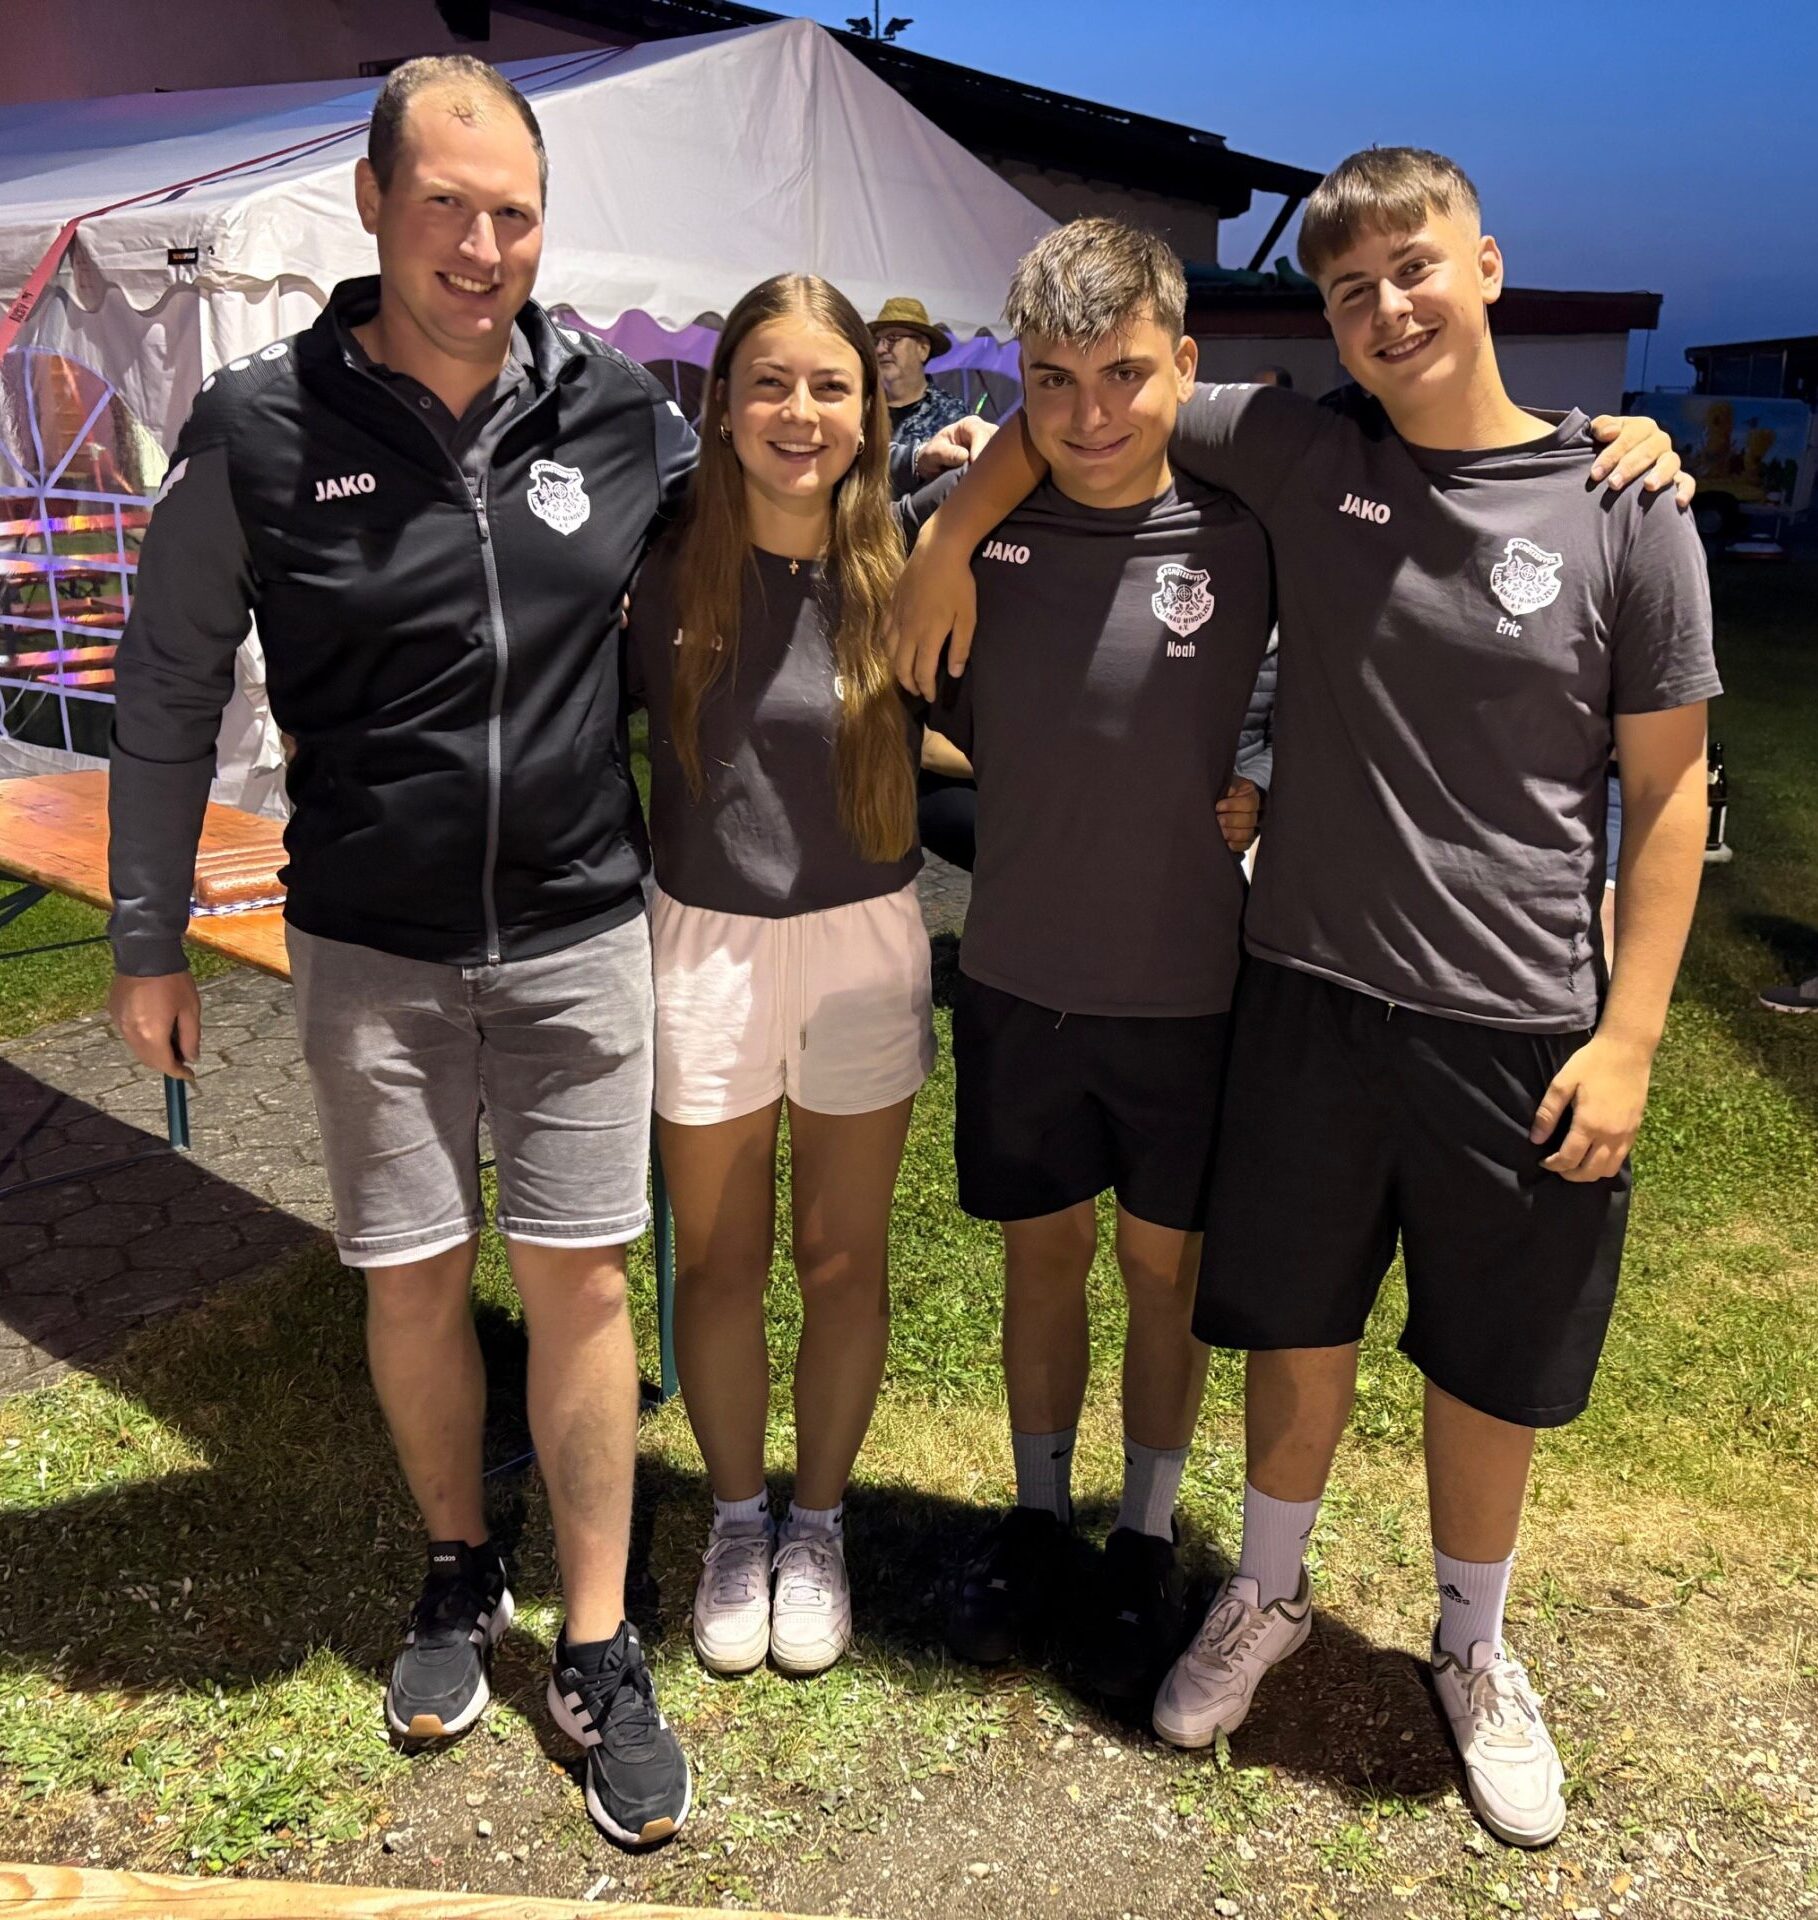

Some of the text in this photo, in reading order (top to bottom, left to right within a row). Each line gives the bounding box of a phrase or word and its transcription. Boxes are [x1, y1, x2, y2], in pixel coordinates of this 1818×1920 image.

[315, 472, 376, 502] JAKO
[1338, 492, 1391, 525] JAKO
[982, 540, 1030, 565] JAKO
[1496, 616, 1522, 638] Eric
[1166, 641, 1196, 658] Noah
